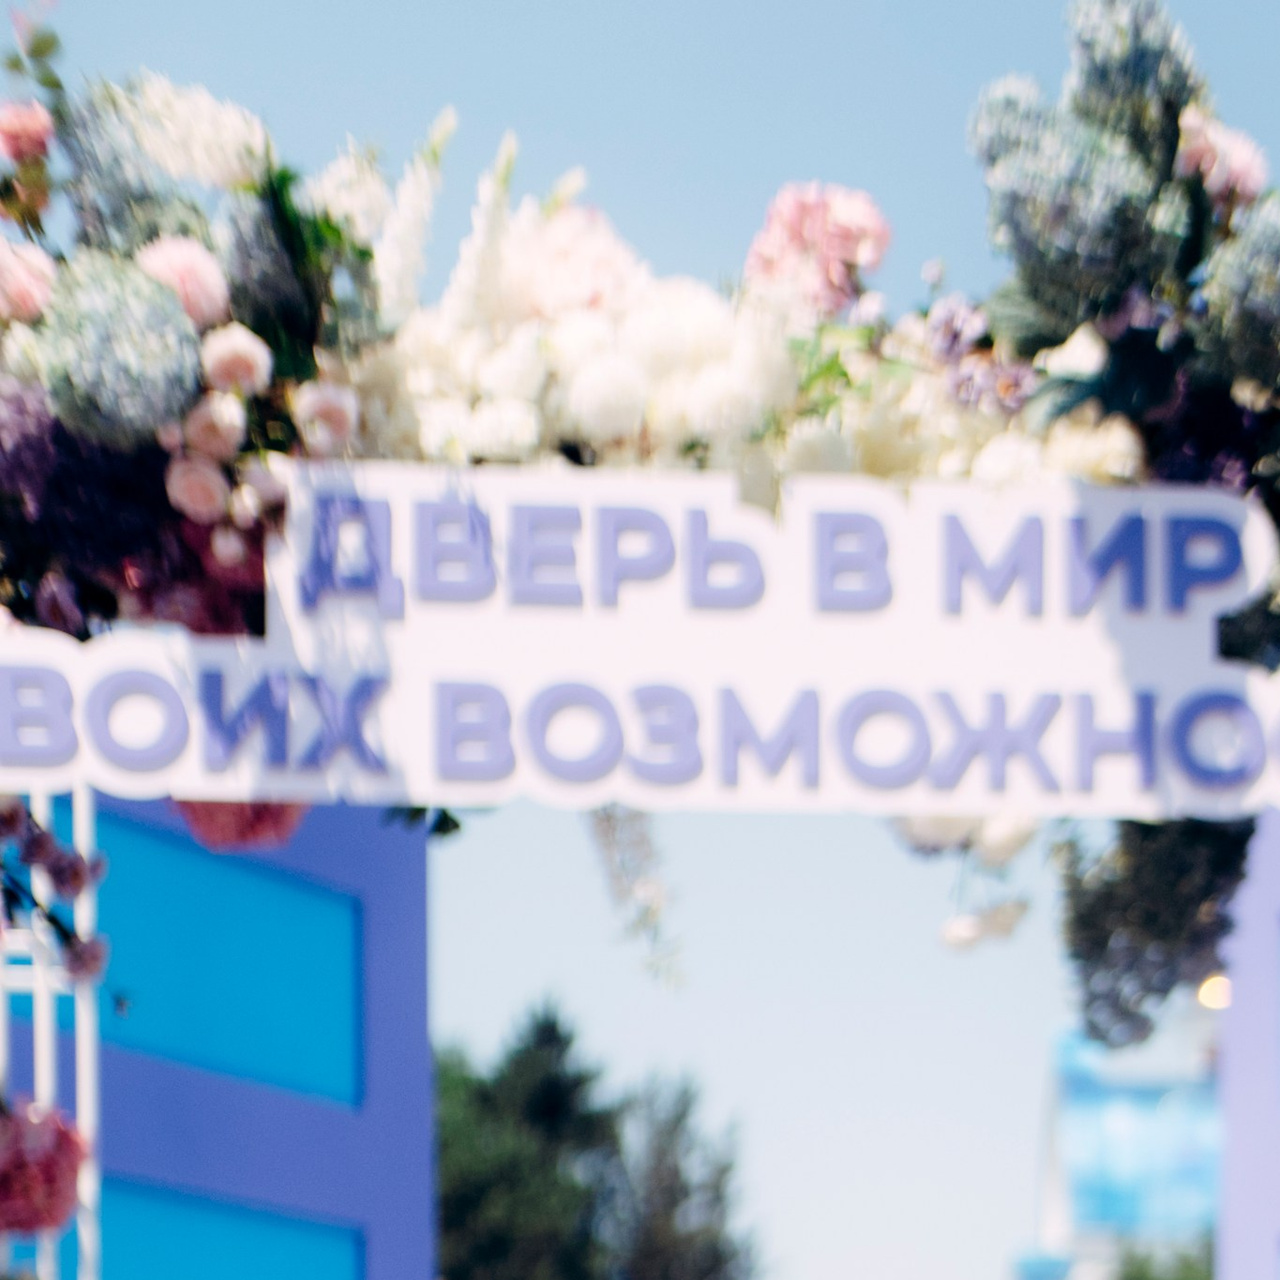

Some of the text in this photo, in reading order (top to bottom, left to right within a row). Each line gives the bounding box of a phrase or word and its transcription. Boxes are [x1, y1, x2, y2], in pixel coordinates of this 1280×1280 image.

[301, 496, 1245, 621] ДВЕРЬ В МИР
[0, 665, 388, 776] ВОИХ
